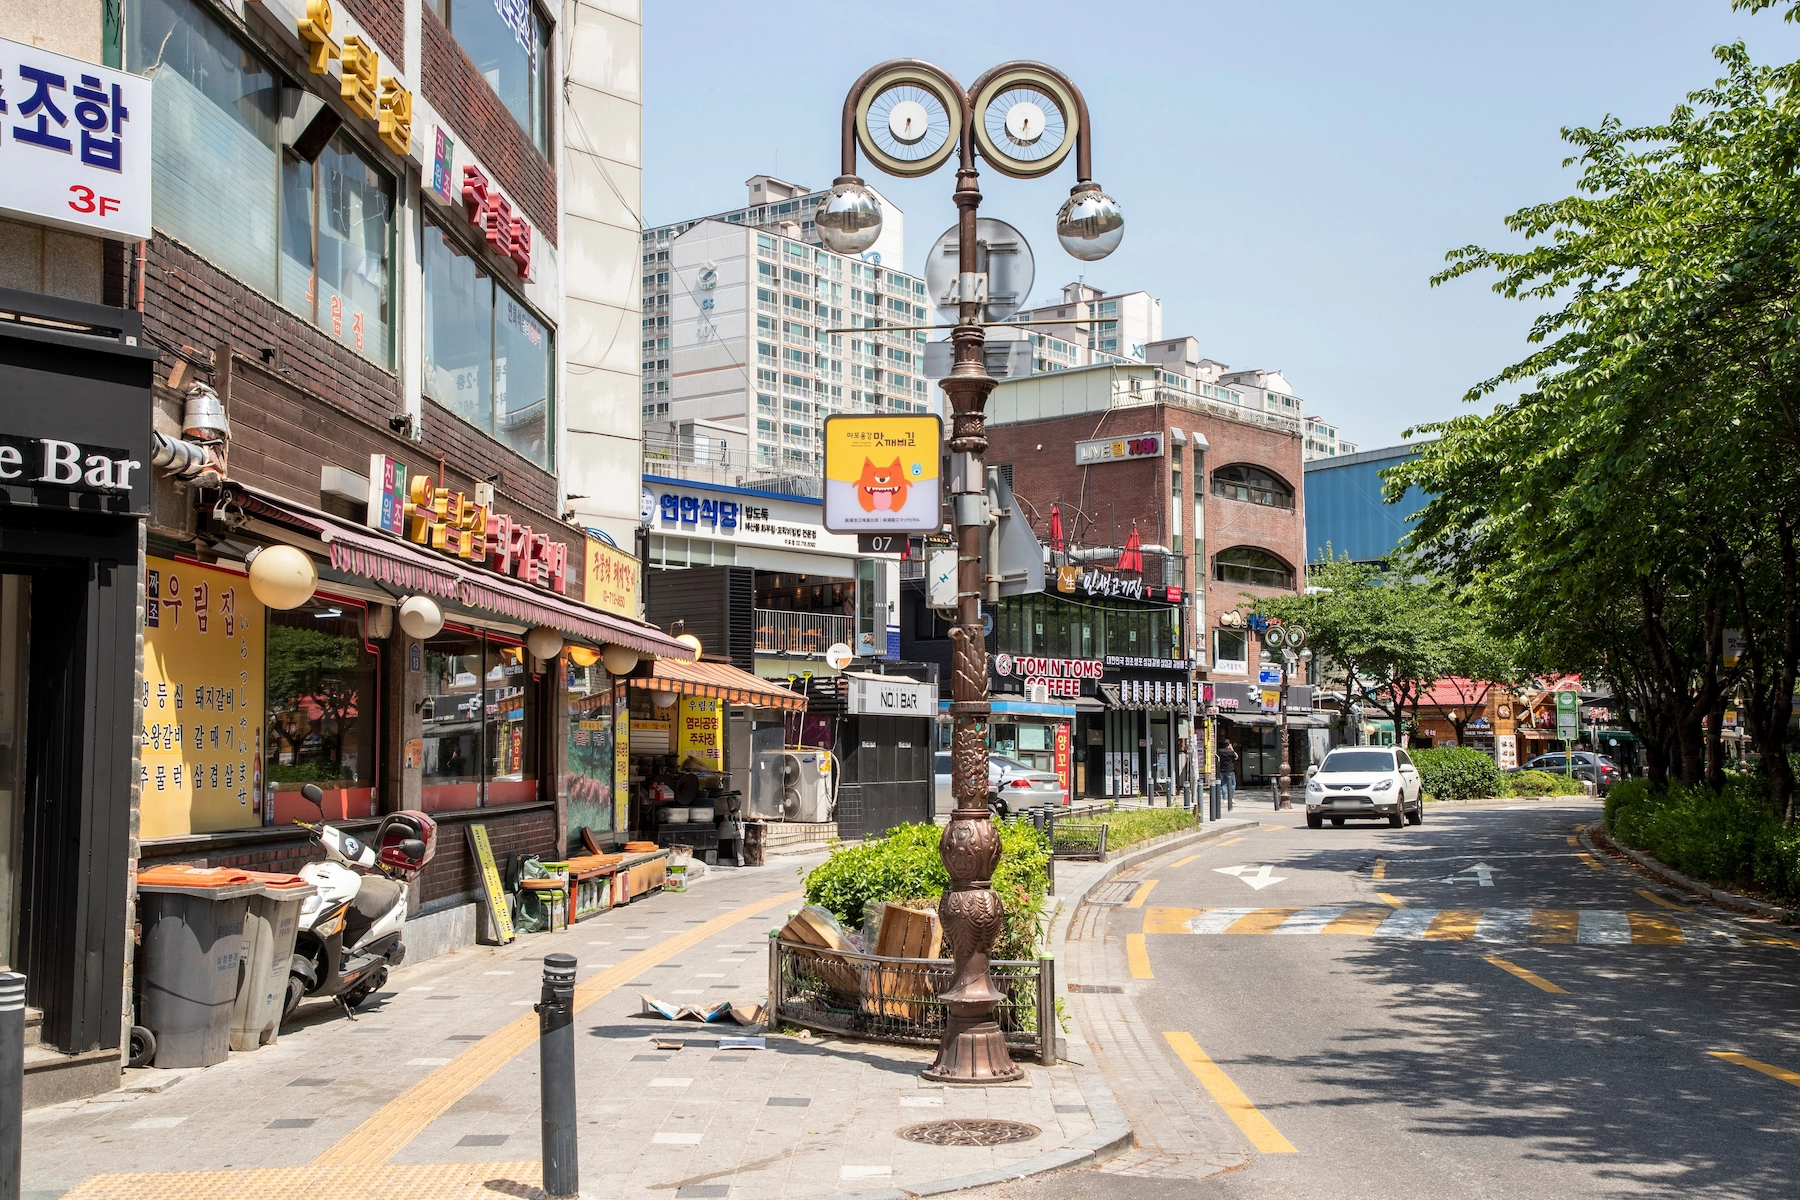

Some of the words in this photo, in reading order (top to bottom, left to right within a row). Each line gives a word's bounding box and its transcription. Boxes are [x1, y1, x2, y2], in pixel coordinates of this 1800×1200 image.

[297, 0, 413, 156] 우림집
[0, 63, 131, 175] 조합
[434, 164, 450, 197] 원조
[68, 185, 121, 217] 3F
[462, 164, 531, 279] 주물럭
[701, 298, 715, 310] GS
[846, 432, 872, 440] 마포용강
[1081, 443, 1110, 460] LIVE
[1127, 437, 1157, 456] 7080
[39, 438, 141, 490] Bar
[384, 463, 405, 496] 진짜
[382, 496, 403, 527] 원조
[660, 493, 739, 529] 연안식당
[745, 506, 769, 522] 밥도둑
[404, 475, 488, 563] 우림집
[485, 514, 568, 595] 돼지갈비
[872, 536, 893, 551] 07
[1058, 567, 1076, 590] 人生
[1083, 568, 1142, 600] 인생고기집
[162, 574, 236, 638] 우림집
[1016, 657, 1047, 676] TOM
[1051, 658, 1060, 677] N
[1064, 660, 1103, 679] TOMS
[195, 685, 235, 714] 돼지갈비
[688, 700, 716, 712] 우림집
[901, 693, 918, 709] BAR
[141, 723, 183, 750] 소왕갈비
[194, 724, 234, 751] 갈매기
[686, 717, 719, 730] 염리공영
[690, 732, 716, 745] 주차장
[706, 748, 721, 758] 무료
[1057, 735, 1067, 786] 양꼬치
[140, 763, 182, 792] 주물럭
[194, 763, 234, 790] 삼겹살
